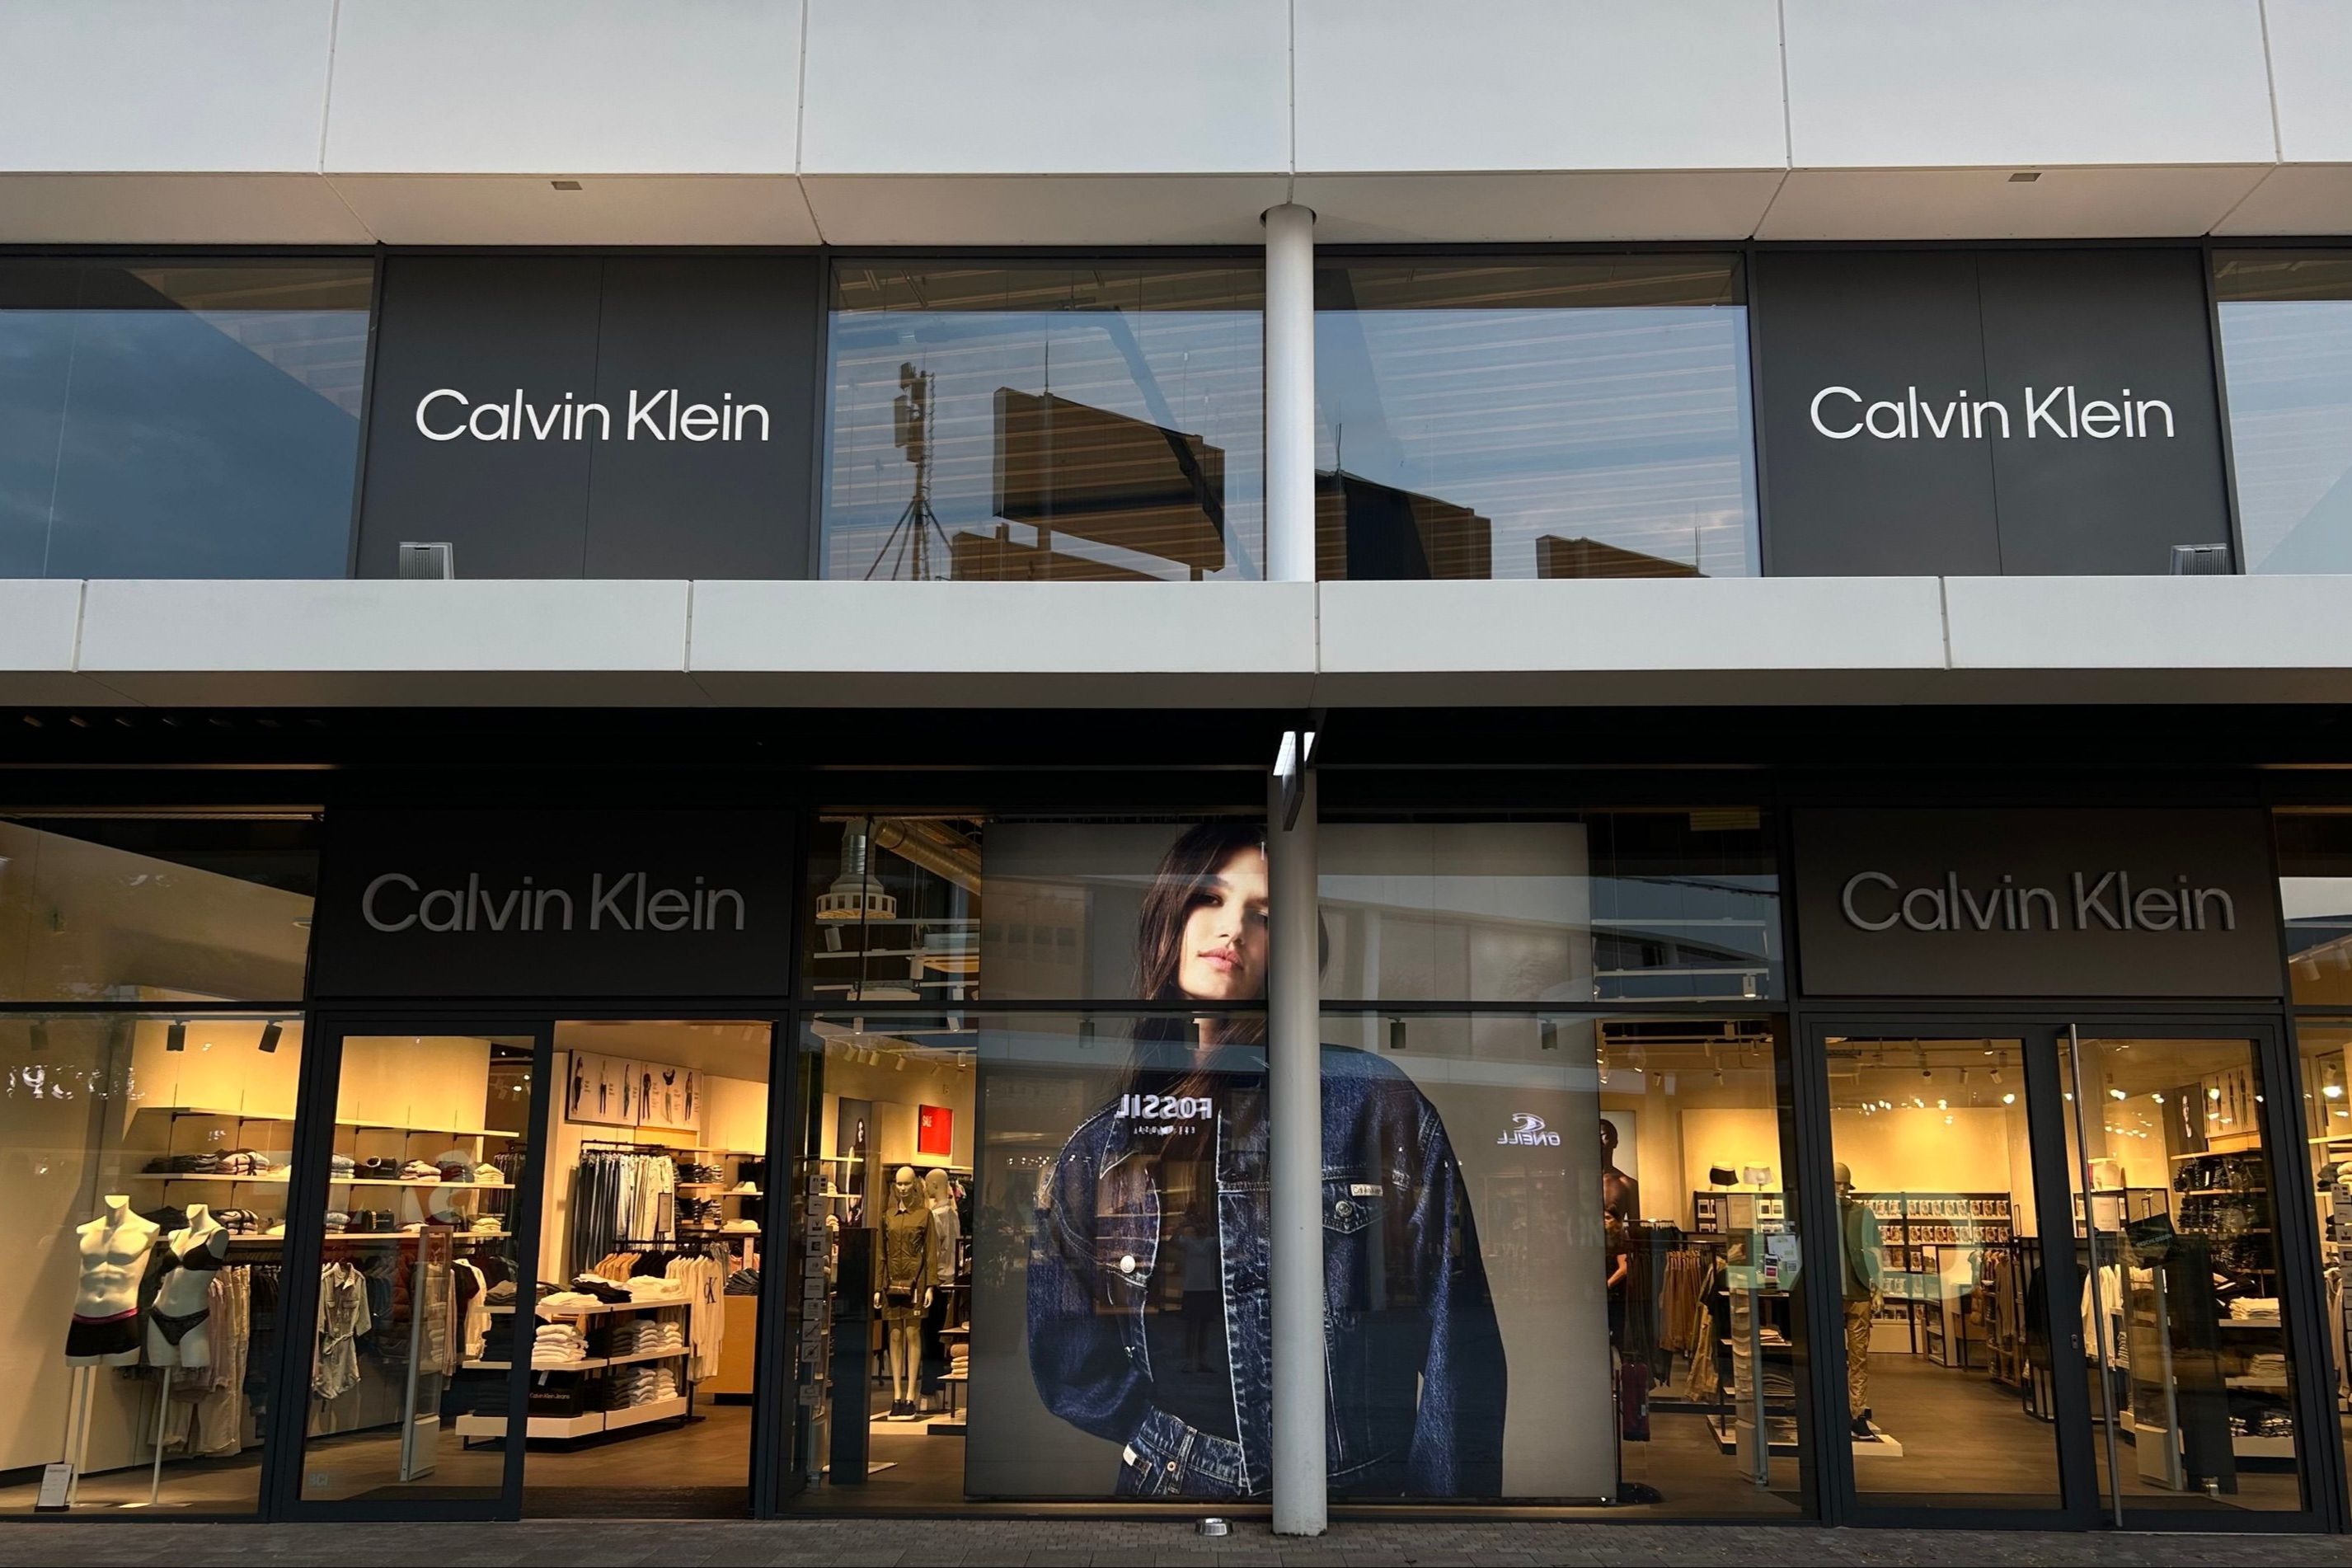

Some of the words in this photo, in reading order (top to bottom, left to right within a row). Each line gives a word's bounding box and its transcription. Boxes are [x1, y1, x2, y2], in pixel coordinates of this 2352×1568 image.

[415, 387, 611, 441] Calvin
[627, 387, 770, 442] Klein
[1810, 385, 2011, 439] Calvin
[2025, 385, 2175, 439] Klein
[361, 872, 574, 932] Calvin
[589, 871, 746, 932] Klein
[1841, 871, 2059, 932] Calvin
[2073, 871, 2237, 932] Klein
